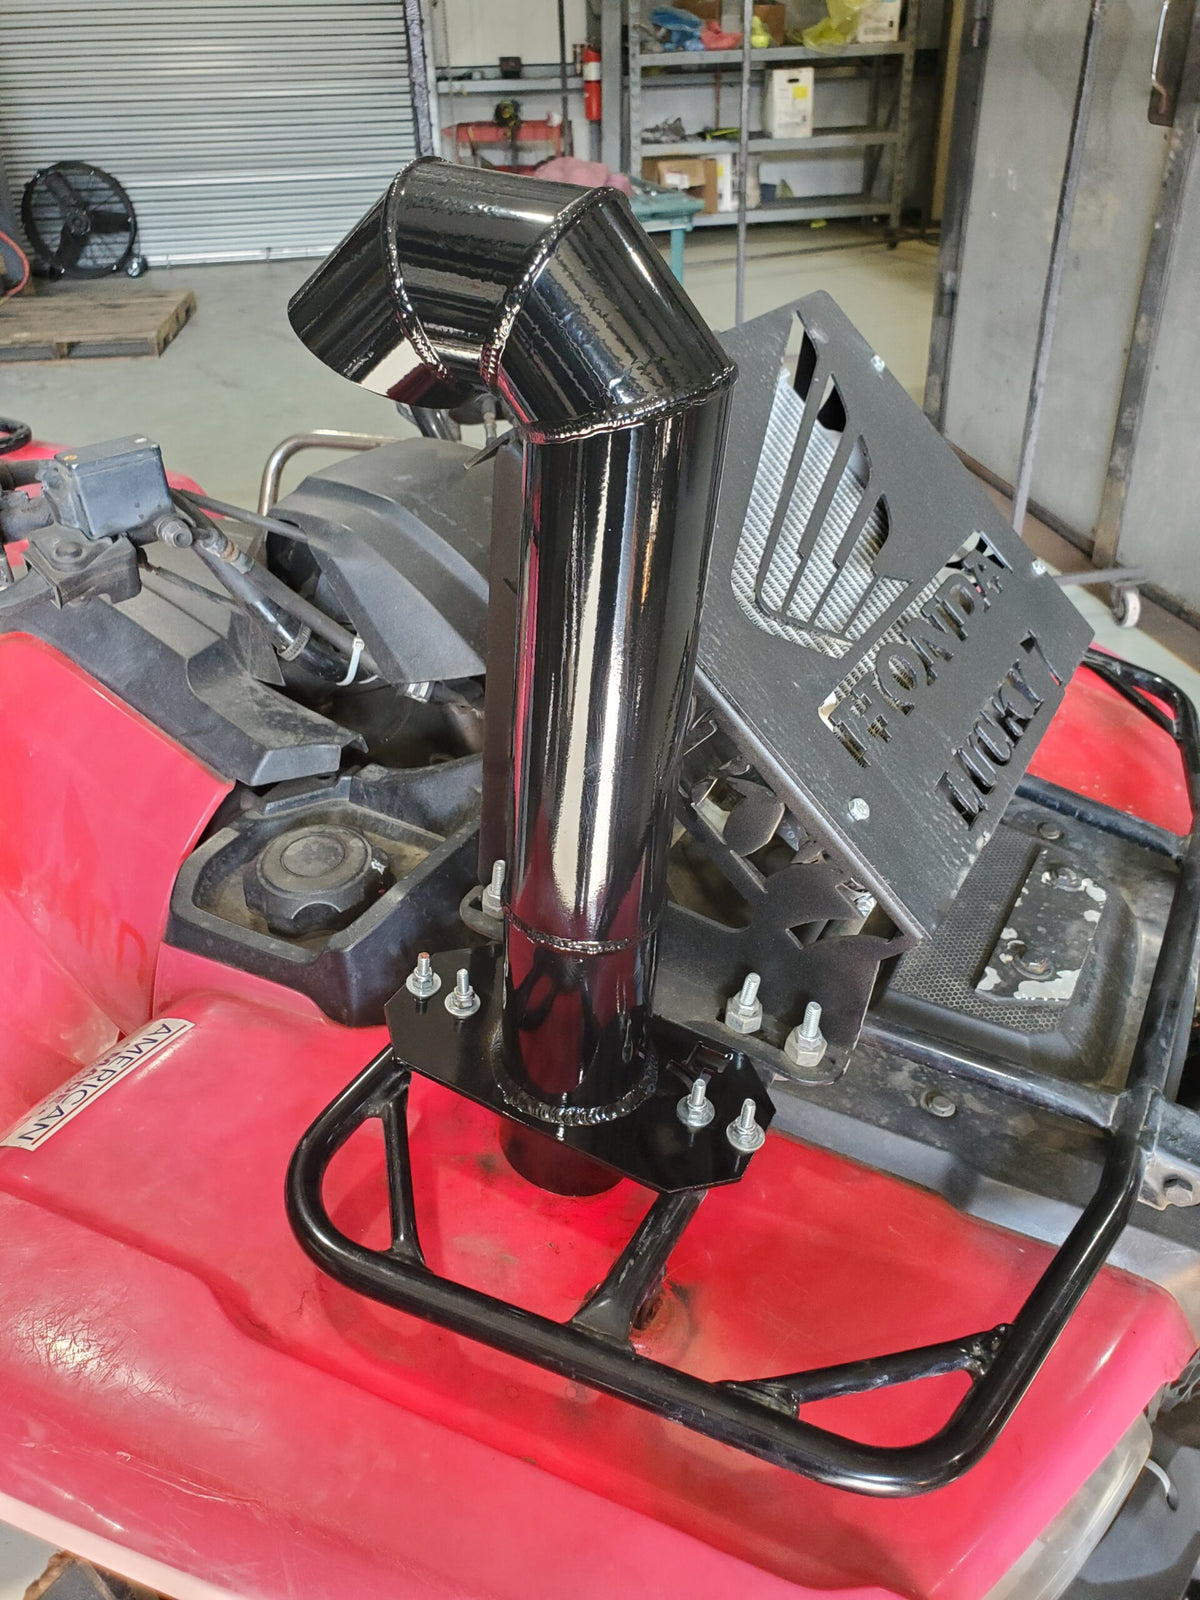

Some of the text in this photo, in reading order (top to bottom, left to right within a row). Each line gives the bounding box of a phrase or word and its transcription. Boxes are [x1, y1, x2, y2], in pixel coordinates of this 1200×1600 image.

[817, 530, 1014, 769] HONDA
[935, 629, 1064, 832] LUCKY 7
[18, 1023, 172, 1141] AMERICAN
